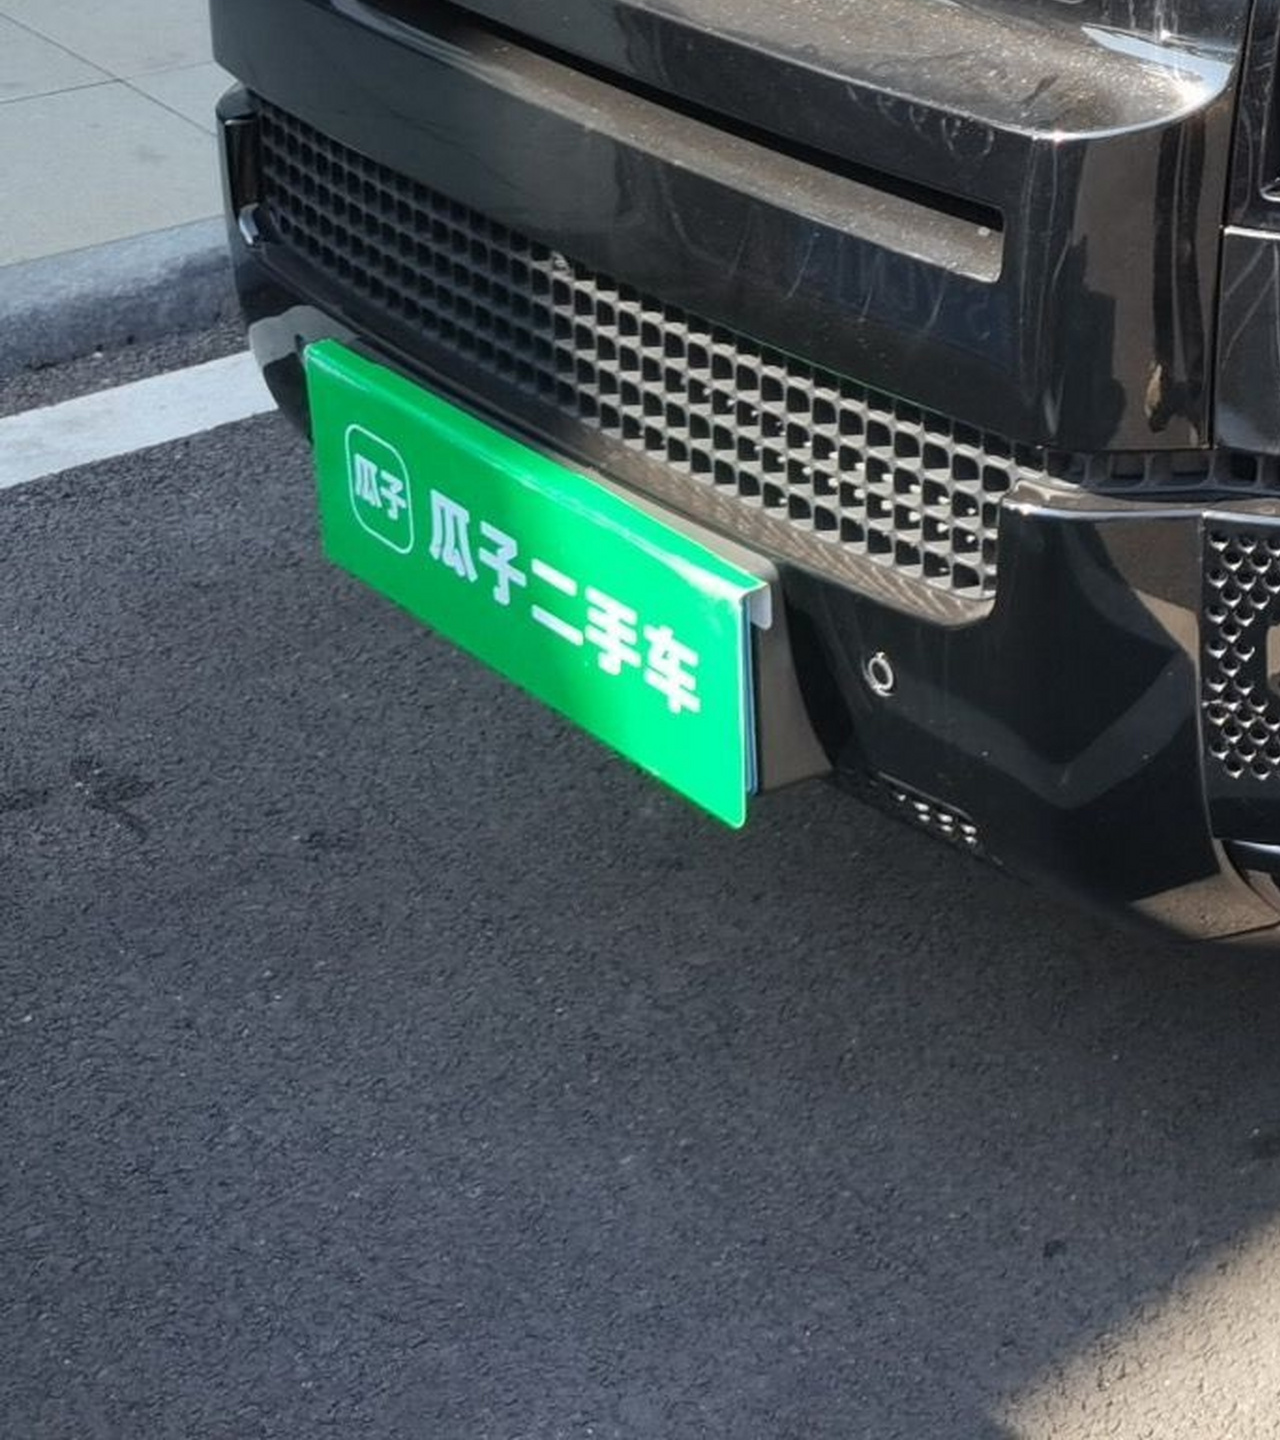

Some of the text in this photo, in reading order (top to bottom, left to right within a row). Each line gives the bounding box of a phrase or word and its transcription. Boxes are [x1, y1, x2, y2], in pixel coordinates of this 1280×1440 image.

[352, 452, 408, 520] 瓜子
[429, 487, 702, 715] 瓜子二手车
